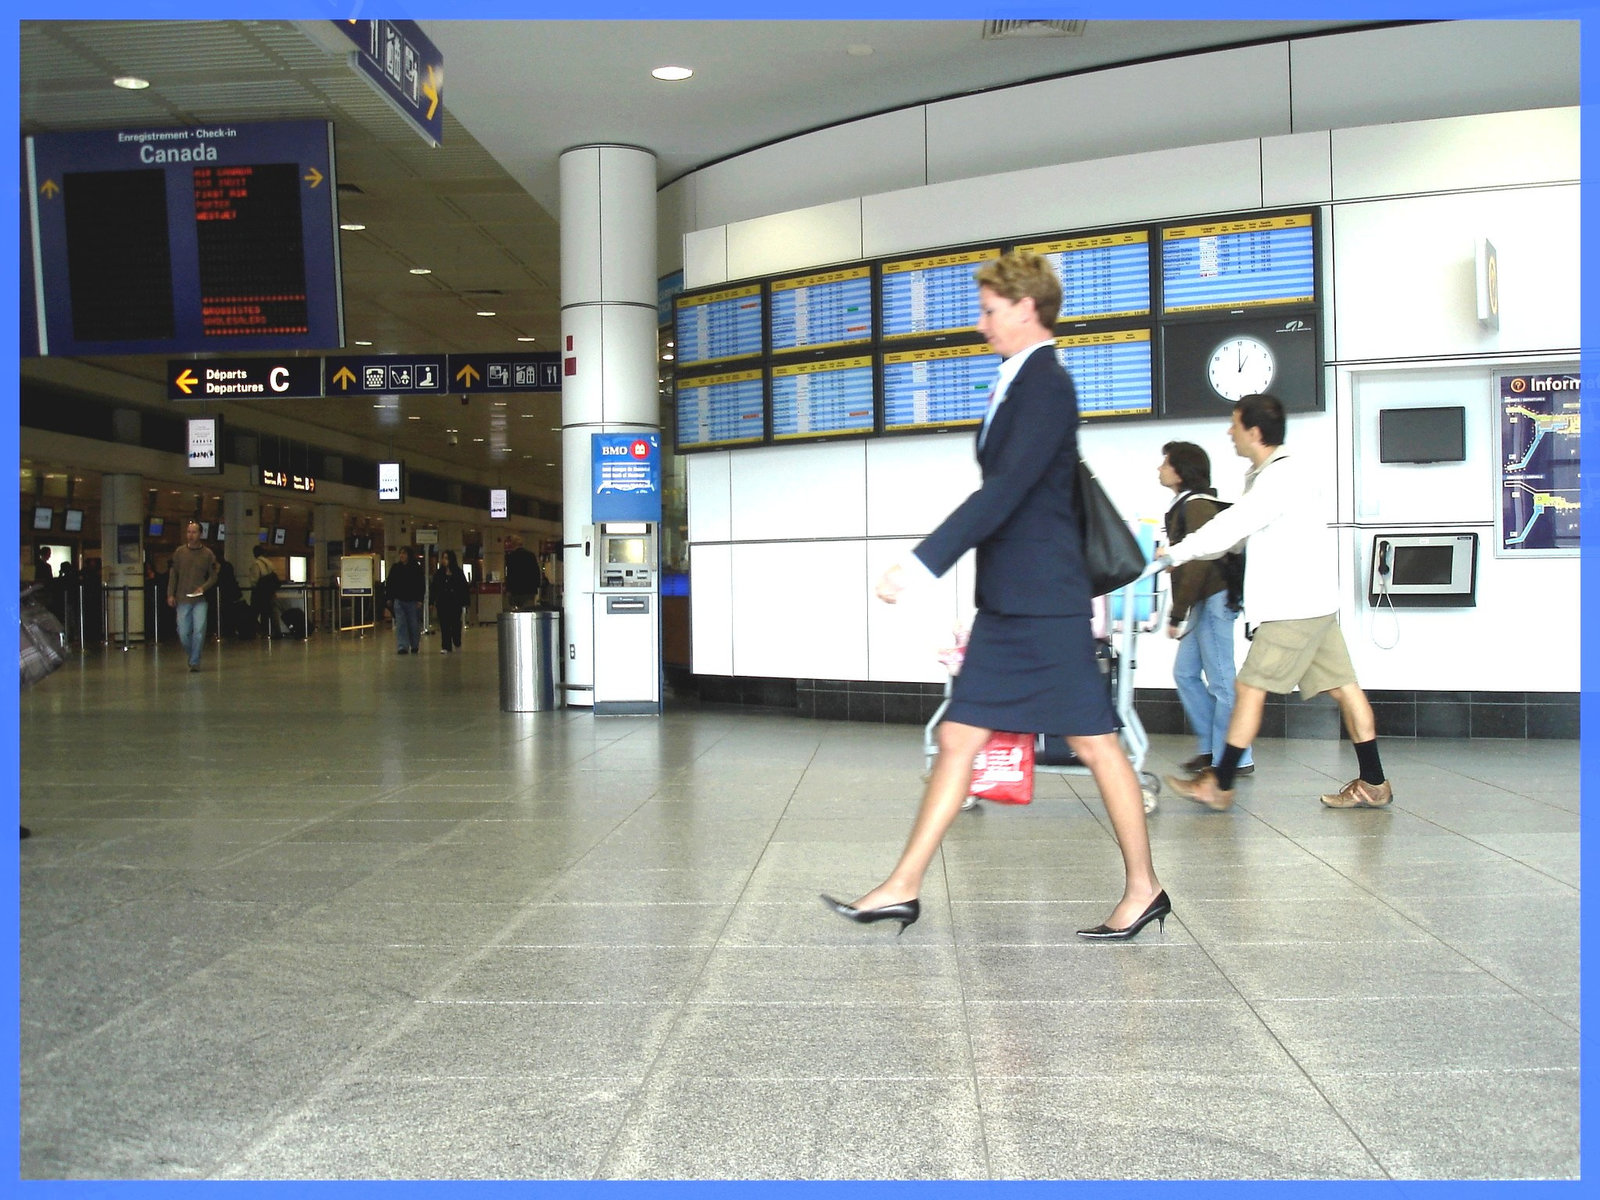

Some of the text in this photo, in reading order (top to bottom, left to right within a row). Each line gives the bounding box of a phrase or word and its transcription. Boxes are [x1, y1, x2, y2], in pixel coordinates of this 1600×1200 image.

[118, 128, 237, 143] Enregistrement Check-in
[140, 142, 218, 164] Canada
[206, 368, 248, 381] Départs
[269, 366, 290, 392] C
[206, 382, 264, 395] Departures
[602, 446, 628, 456] BMO
